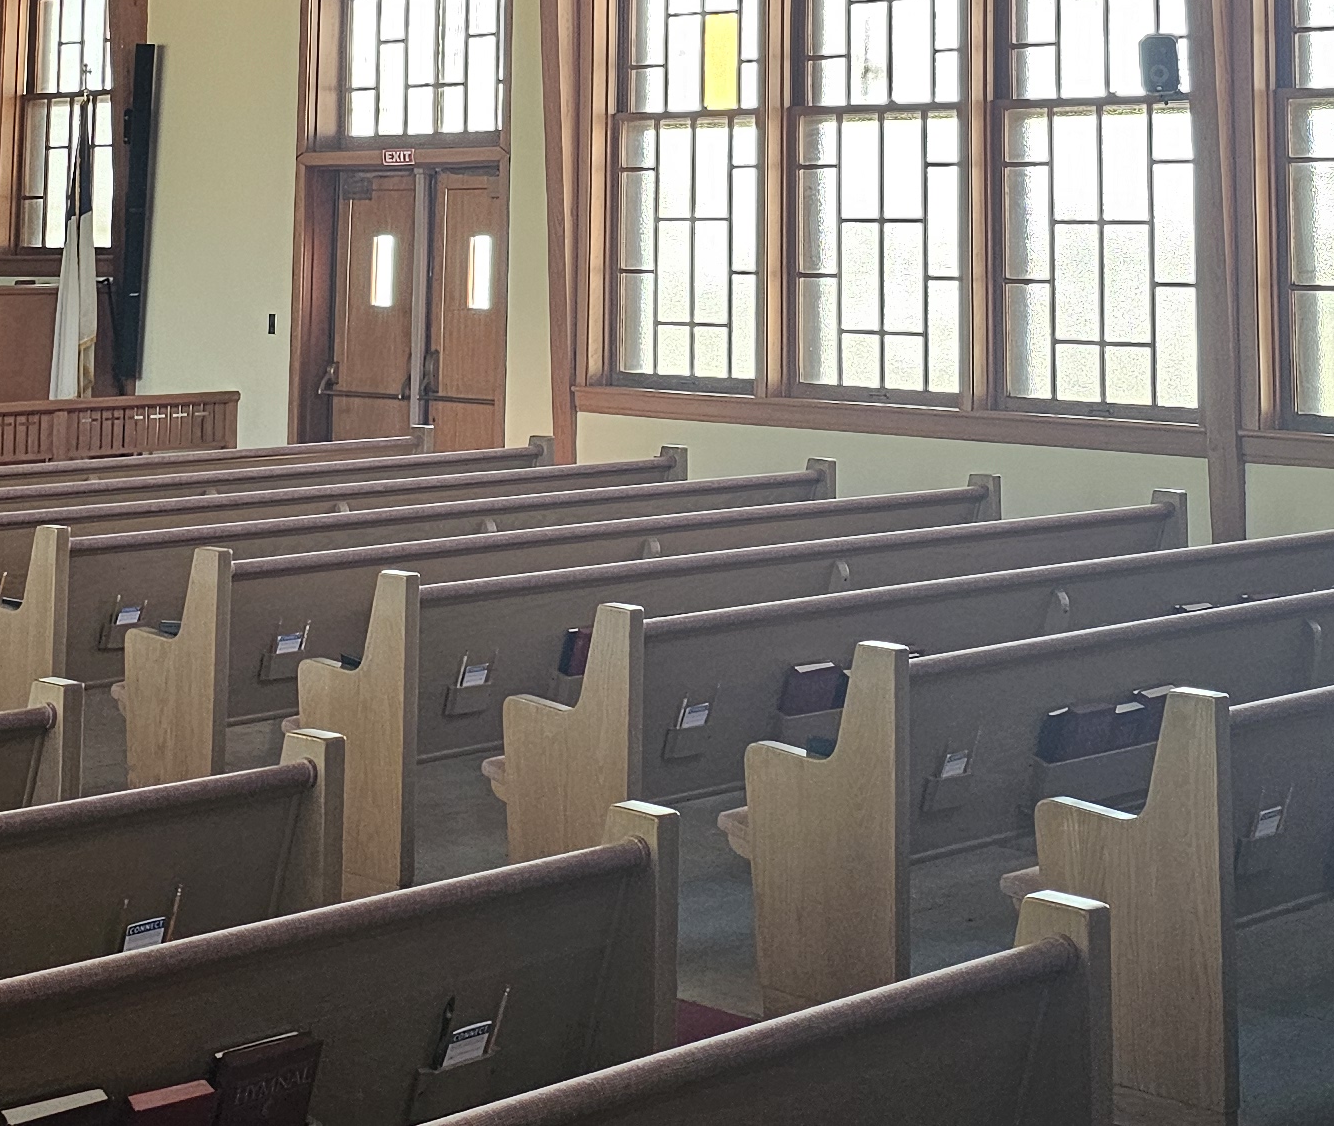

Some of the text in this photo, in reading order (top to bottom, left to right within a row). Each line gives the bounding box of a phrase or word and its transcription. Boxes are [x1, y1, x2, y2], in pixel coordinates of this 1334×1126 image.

[385, 151, 412, 162] EXIT
[129, 920, 164, 935] CONNECT
[234, 1066, 312, 1105] HYMNAL
